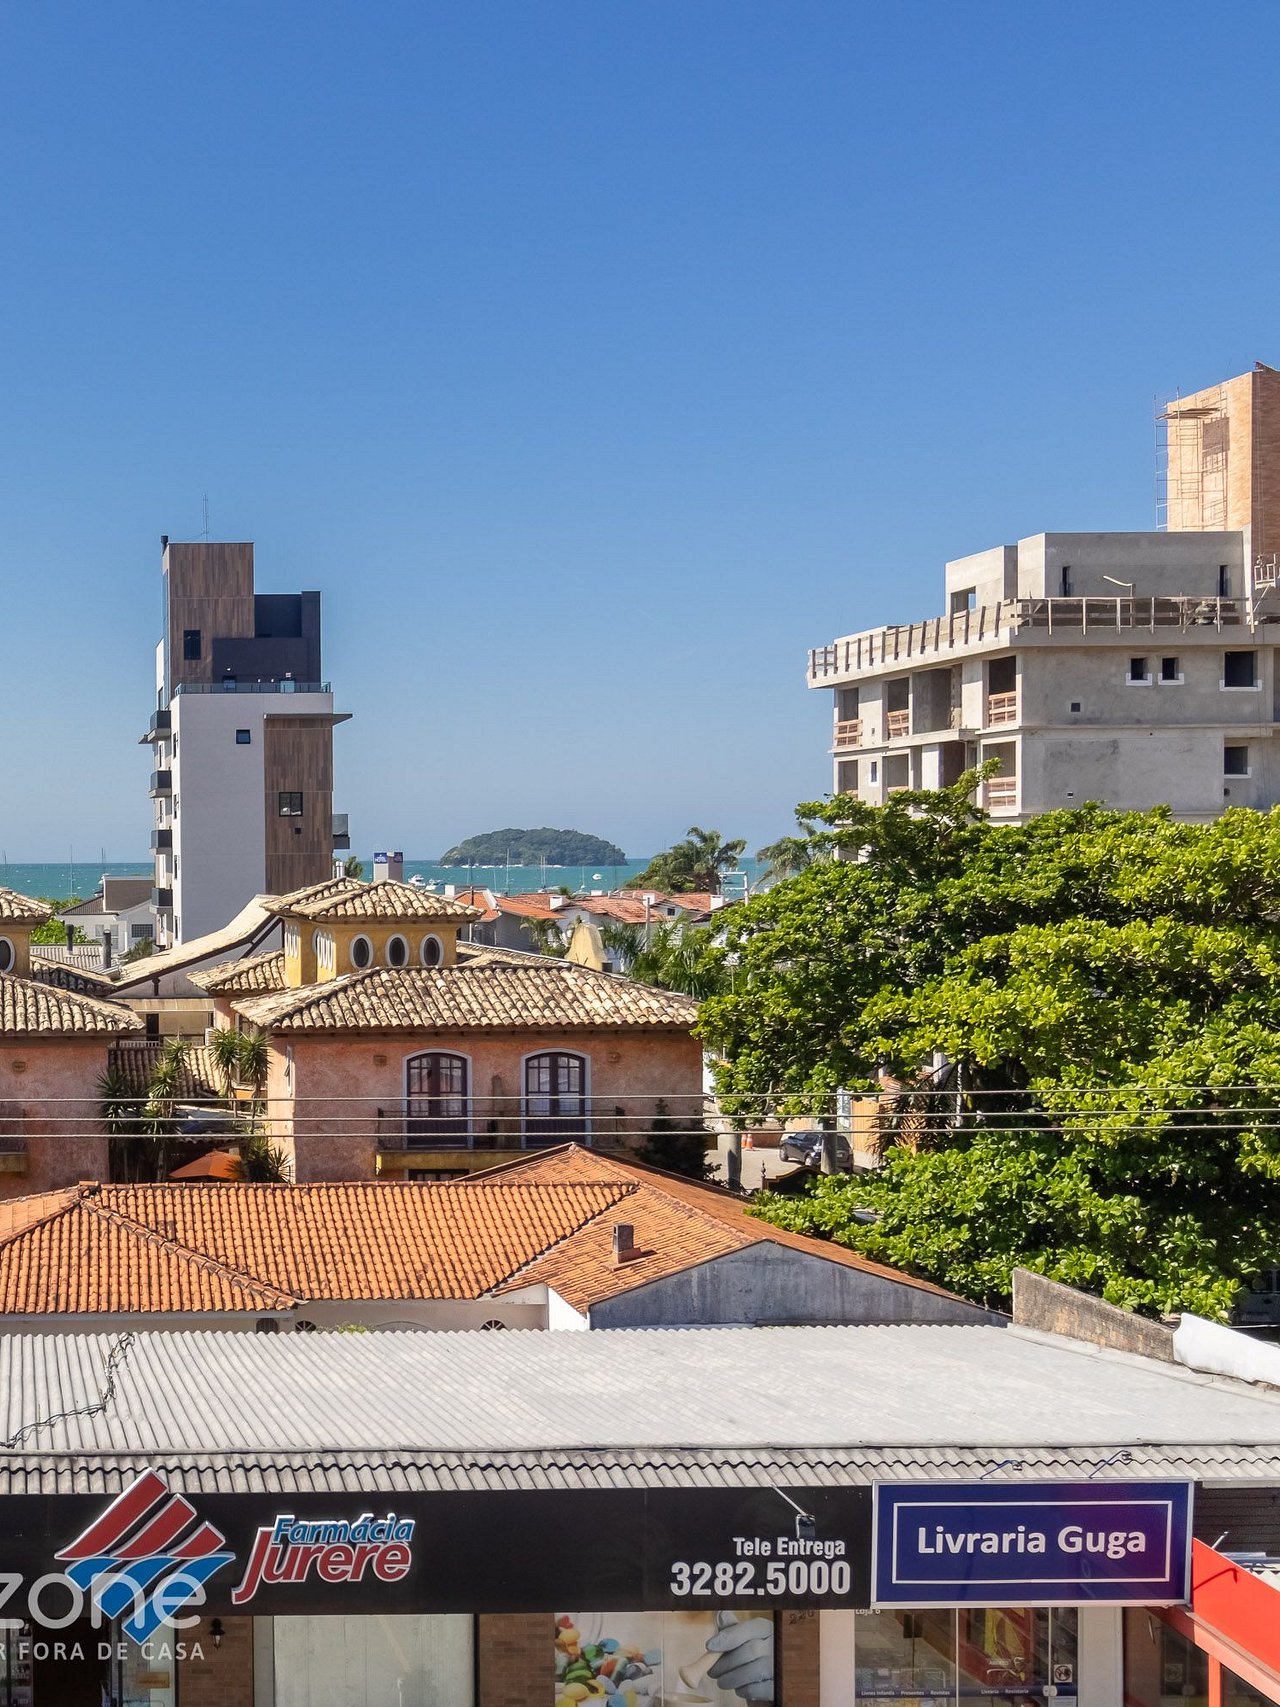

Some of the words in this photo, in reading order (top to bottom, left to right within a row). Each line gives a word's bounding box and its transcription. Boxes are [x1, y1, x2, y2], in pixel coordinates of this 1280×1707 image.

[273, 1513, 415, 1543] Farmácia
[918, 1525, 1046, 1554] Livraria
[1057, 1525, 1147, 1560] Guga
[732, 1537, 771, 1556] Tele
[776, 1537, 846, 1560] Entrega
[670, 1560, 851, 1596] 3282.5000
